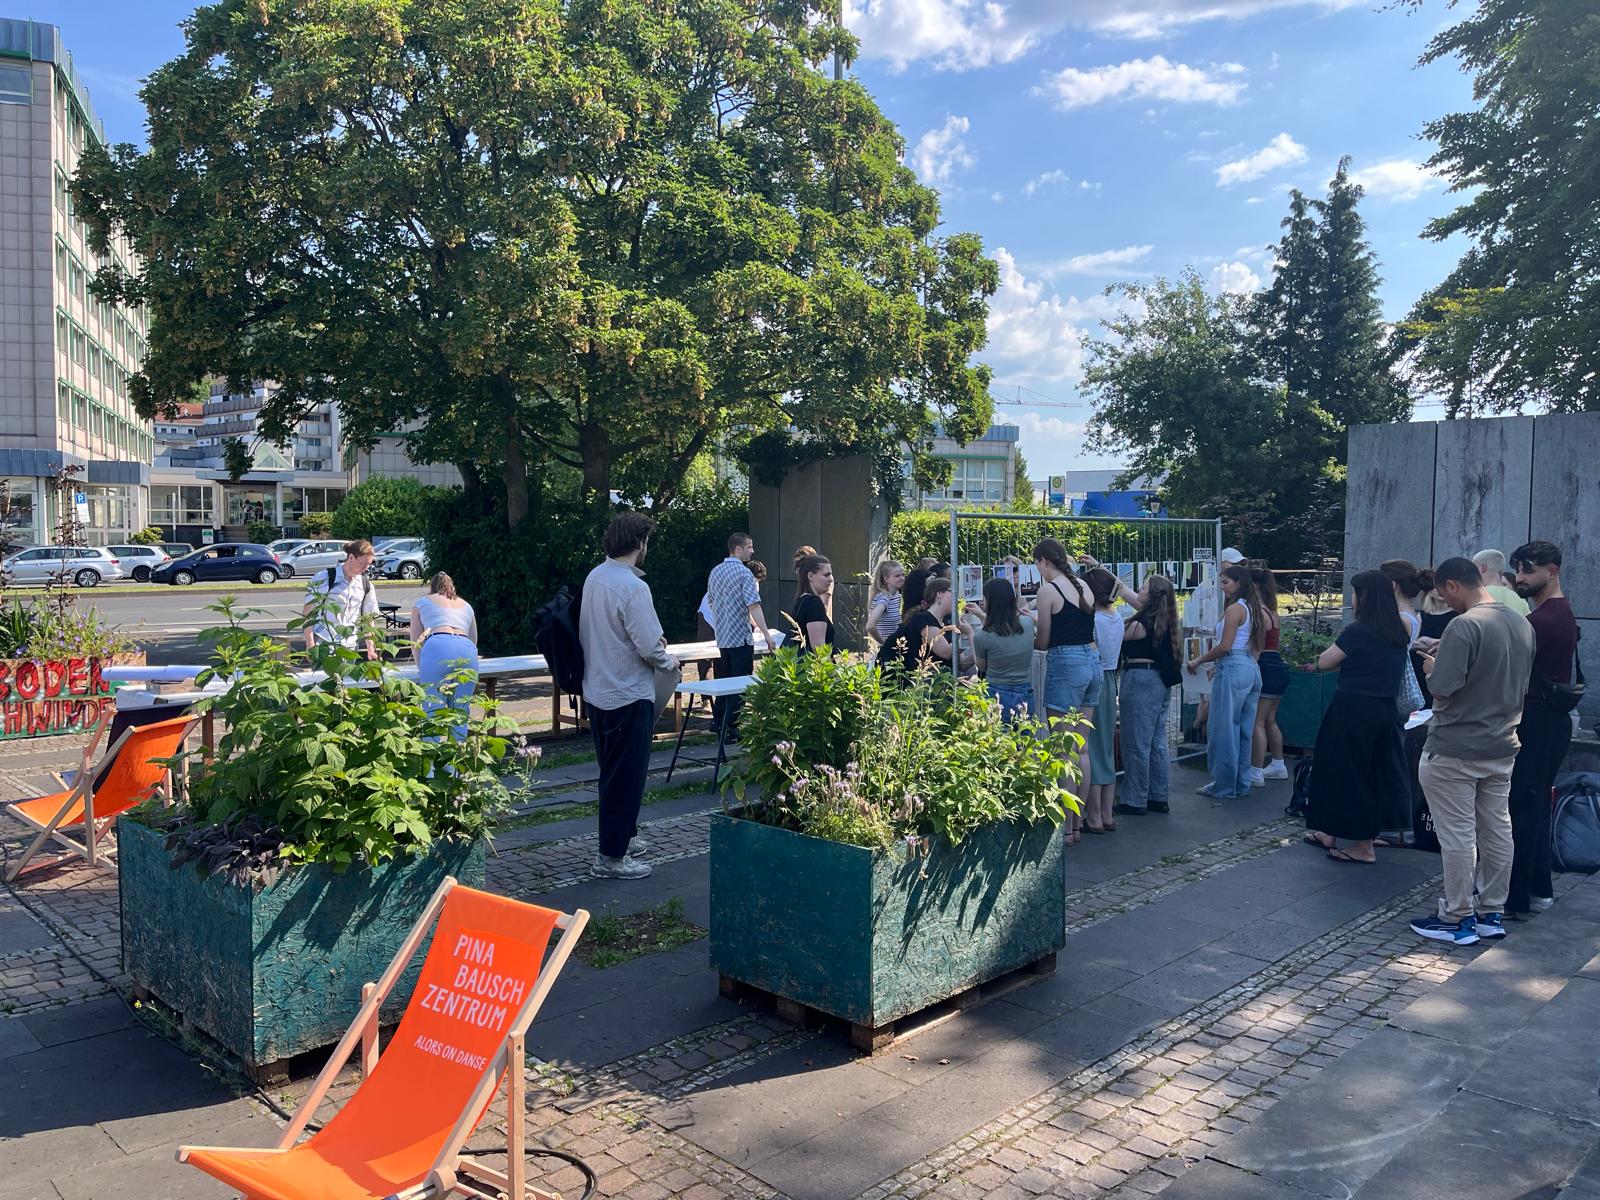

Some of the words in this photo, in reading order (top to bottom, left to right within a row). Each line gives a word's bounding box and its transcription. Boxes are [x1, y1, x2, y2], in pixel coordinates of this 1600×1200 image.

[78, 495, 84, 503] P
[453, 934, 495, 967] PINA
[455, 965, 525, 1005] BAUSCH
[420, 984, 507, 1031] ZENTRUM
[415, 1035, 442, 1056] ALORS
[441, 1045, 456, 1060] ON
[455, 1053, 487, 1071] DANSE
